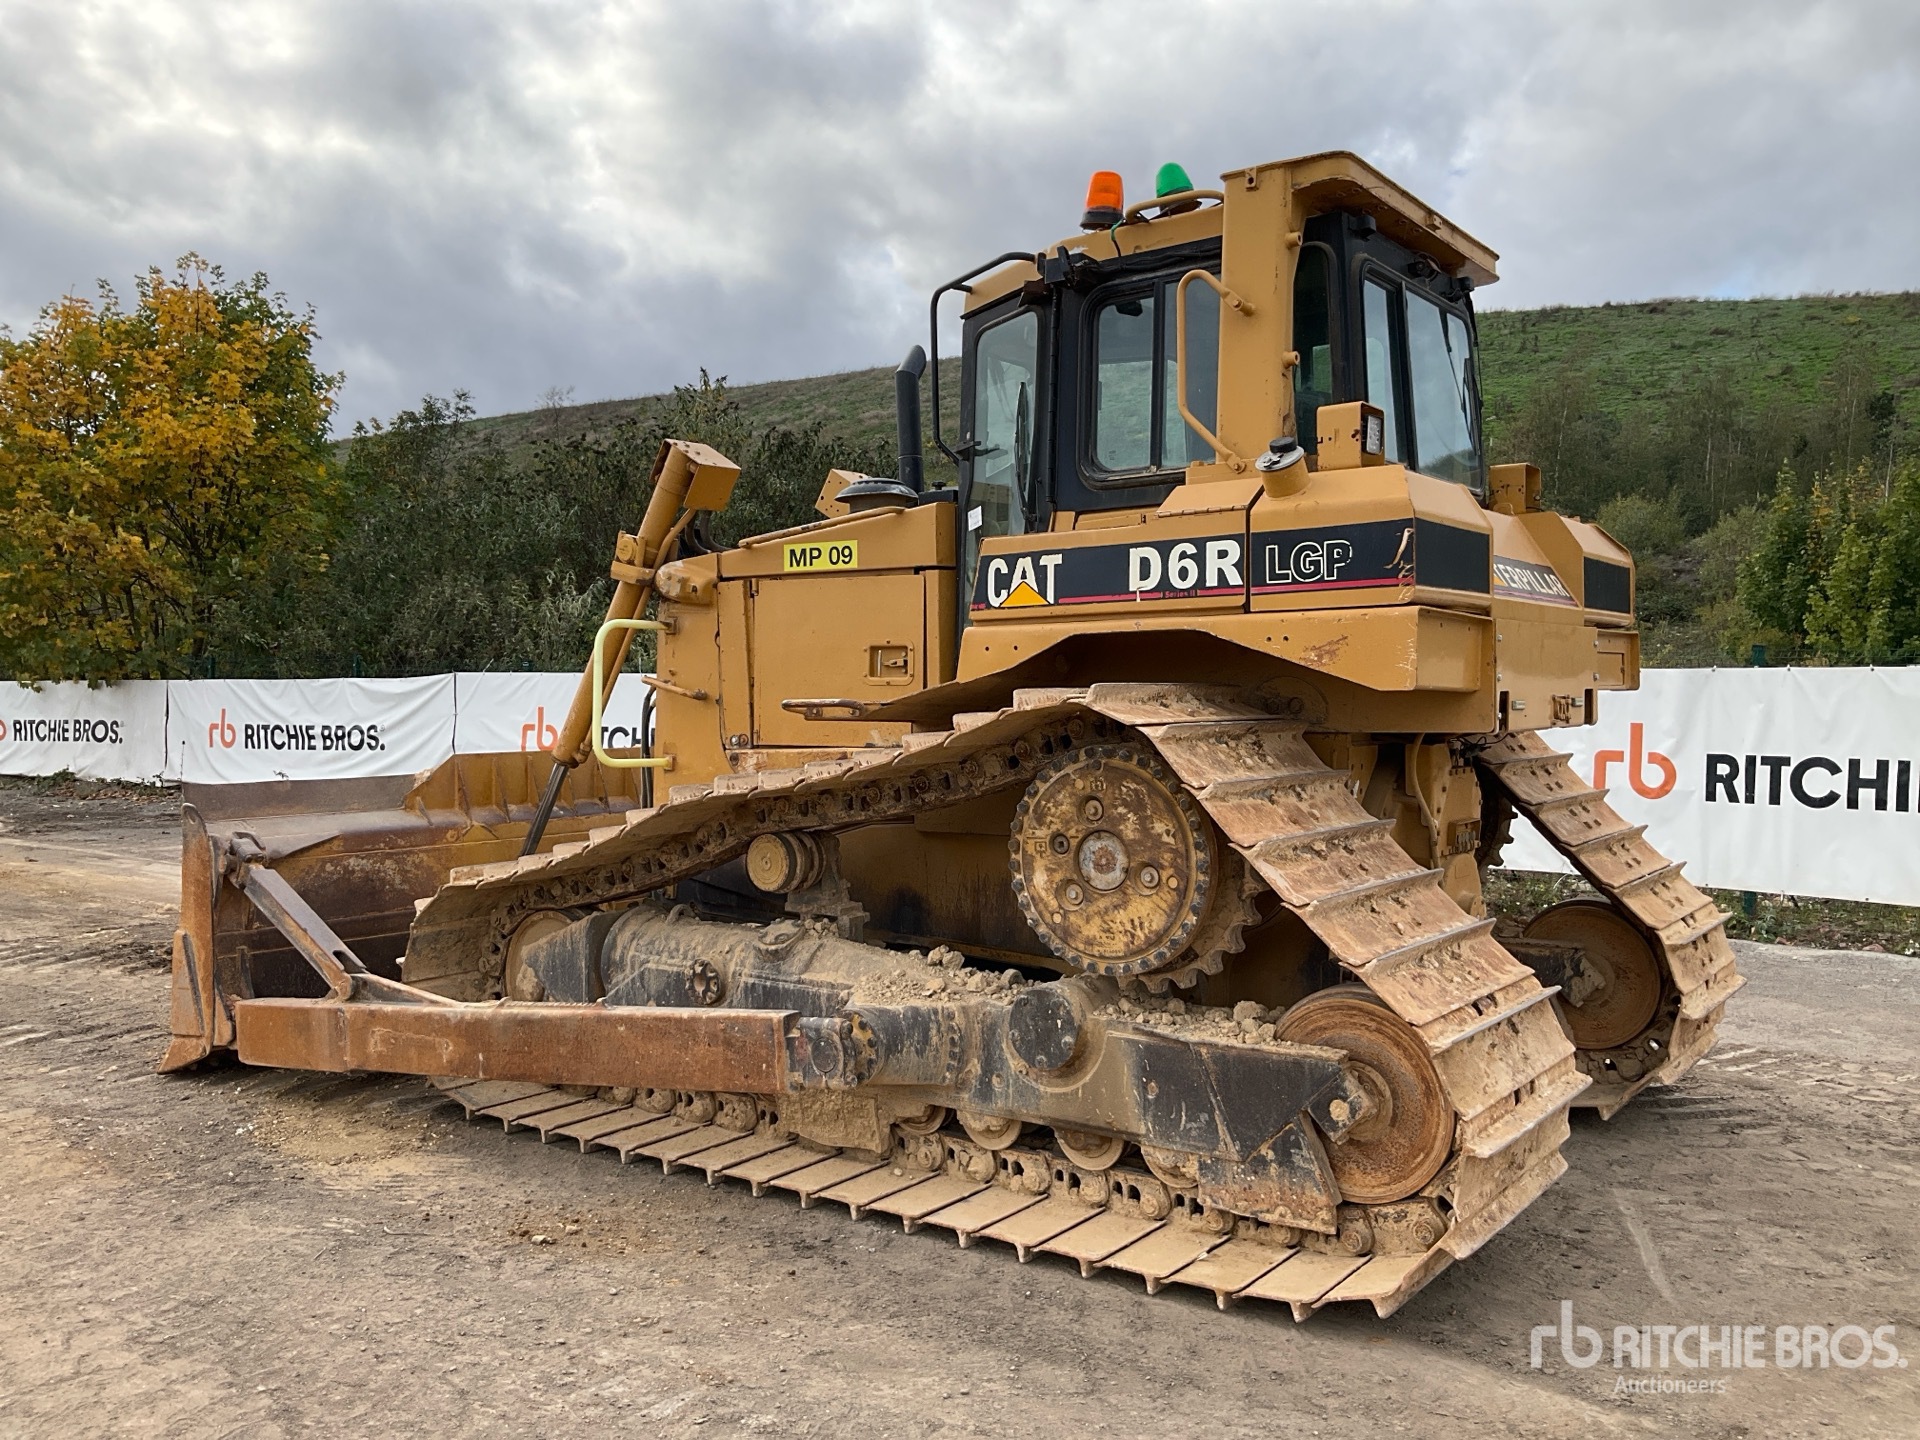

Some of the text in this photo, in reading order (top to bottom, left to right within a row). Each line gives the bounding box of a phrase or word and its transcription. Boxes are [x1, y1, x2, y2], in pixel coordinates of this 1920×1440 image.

[789, 545, 853, 567] MP 09
[1129, 540, 1353, 592] D6R LGP
[987, 553, 1063, 608] CAT
[1493, 563, 1570, 597] TERPILLAR
[13, 719, 69, 742] RITCHIE
[73, 719, 123, 744] BROS.
[209, 708, 237, 749] rb
[244, 724, 317, 750] RITCHIE
[521, 706, 559, 752] rb
[1593, 722, 1920, 814] rb RITCHI
